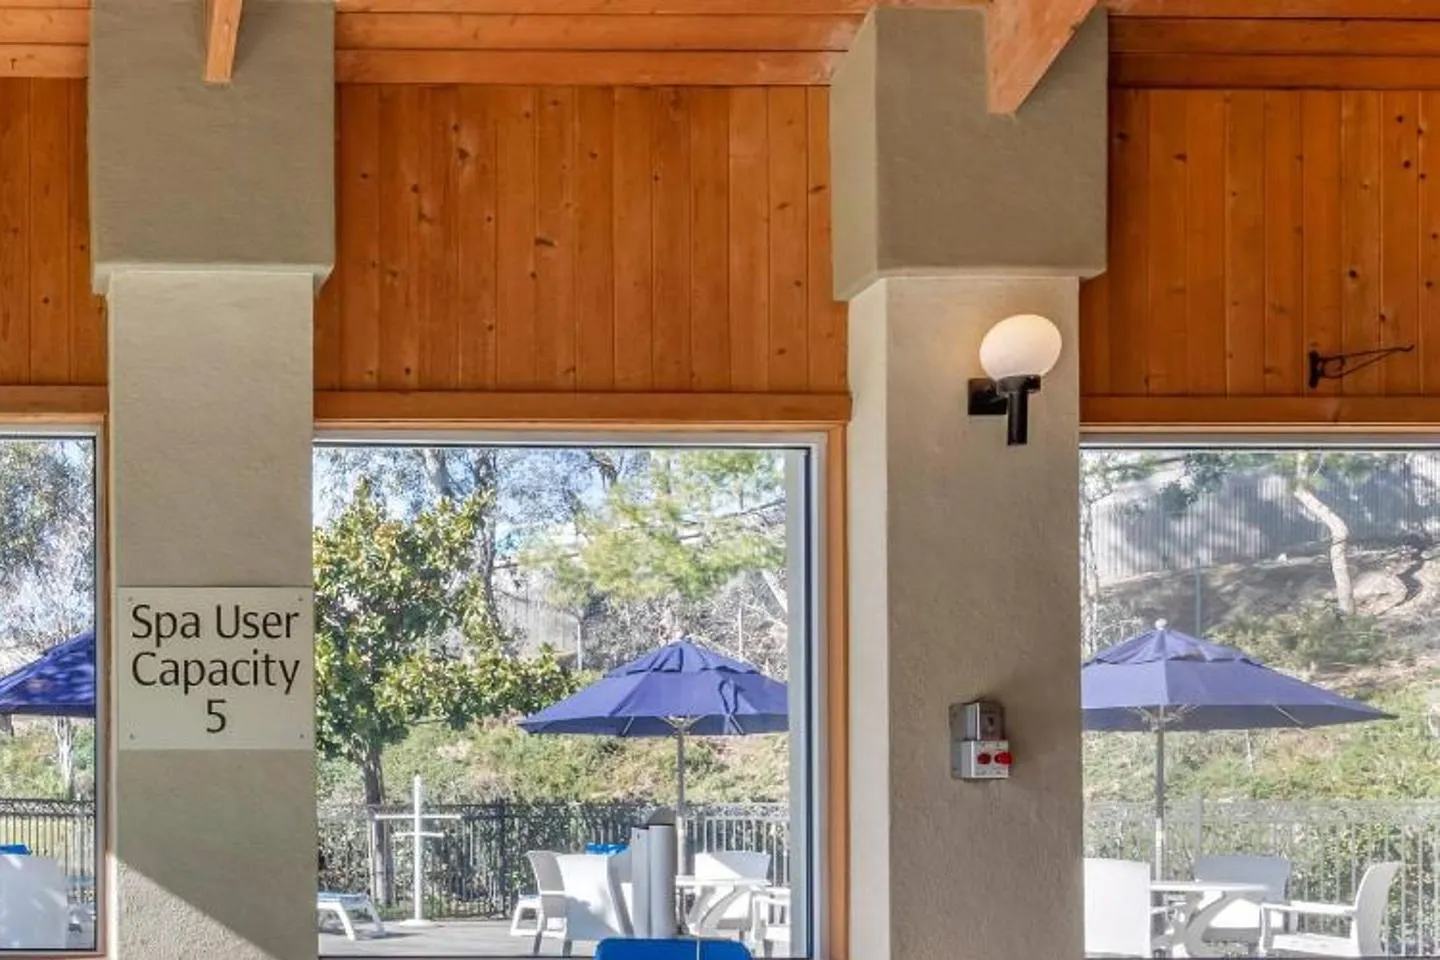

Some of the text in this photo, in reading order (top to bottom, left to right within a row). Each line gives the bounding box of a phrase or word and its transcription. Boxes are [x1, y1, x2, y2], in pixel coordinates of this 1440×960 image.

[131, 604, 300, 648] Spa User
[131, 648, 301, 696] Capacity
[206, 699, 227, 734] 5
